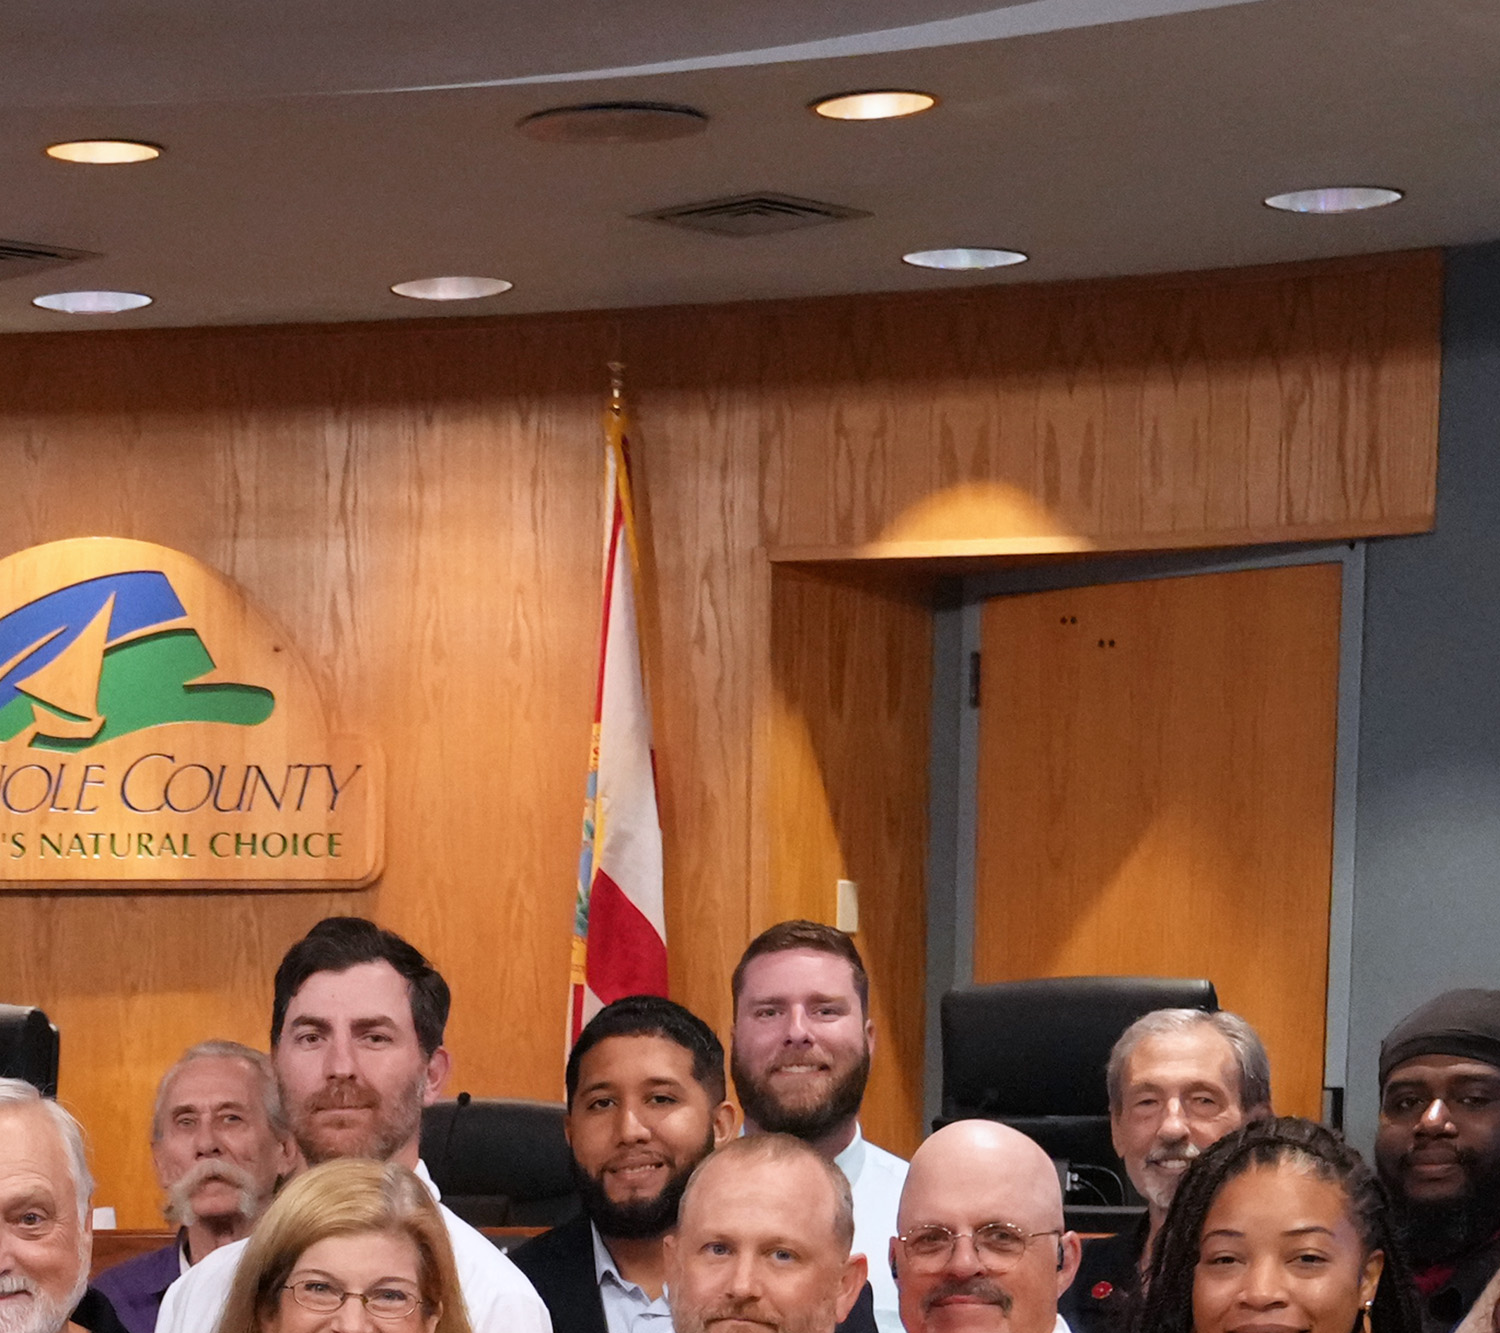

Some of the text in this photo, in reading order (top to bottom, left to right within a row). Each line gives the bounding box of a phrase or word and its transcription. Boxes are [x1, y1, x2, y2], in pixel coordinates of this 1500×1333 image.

[119, 752, 363, 816] COUNTY
[38, 831, 198, 861] NATURAL
[207, 831, 343, 860] CHOICE
